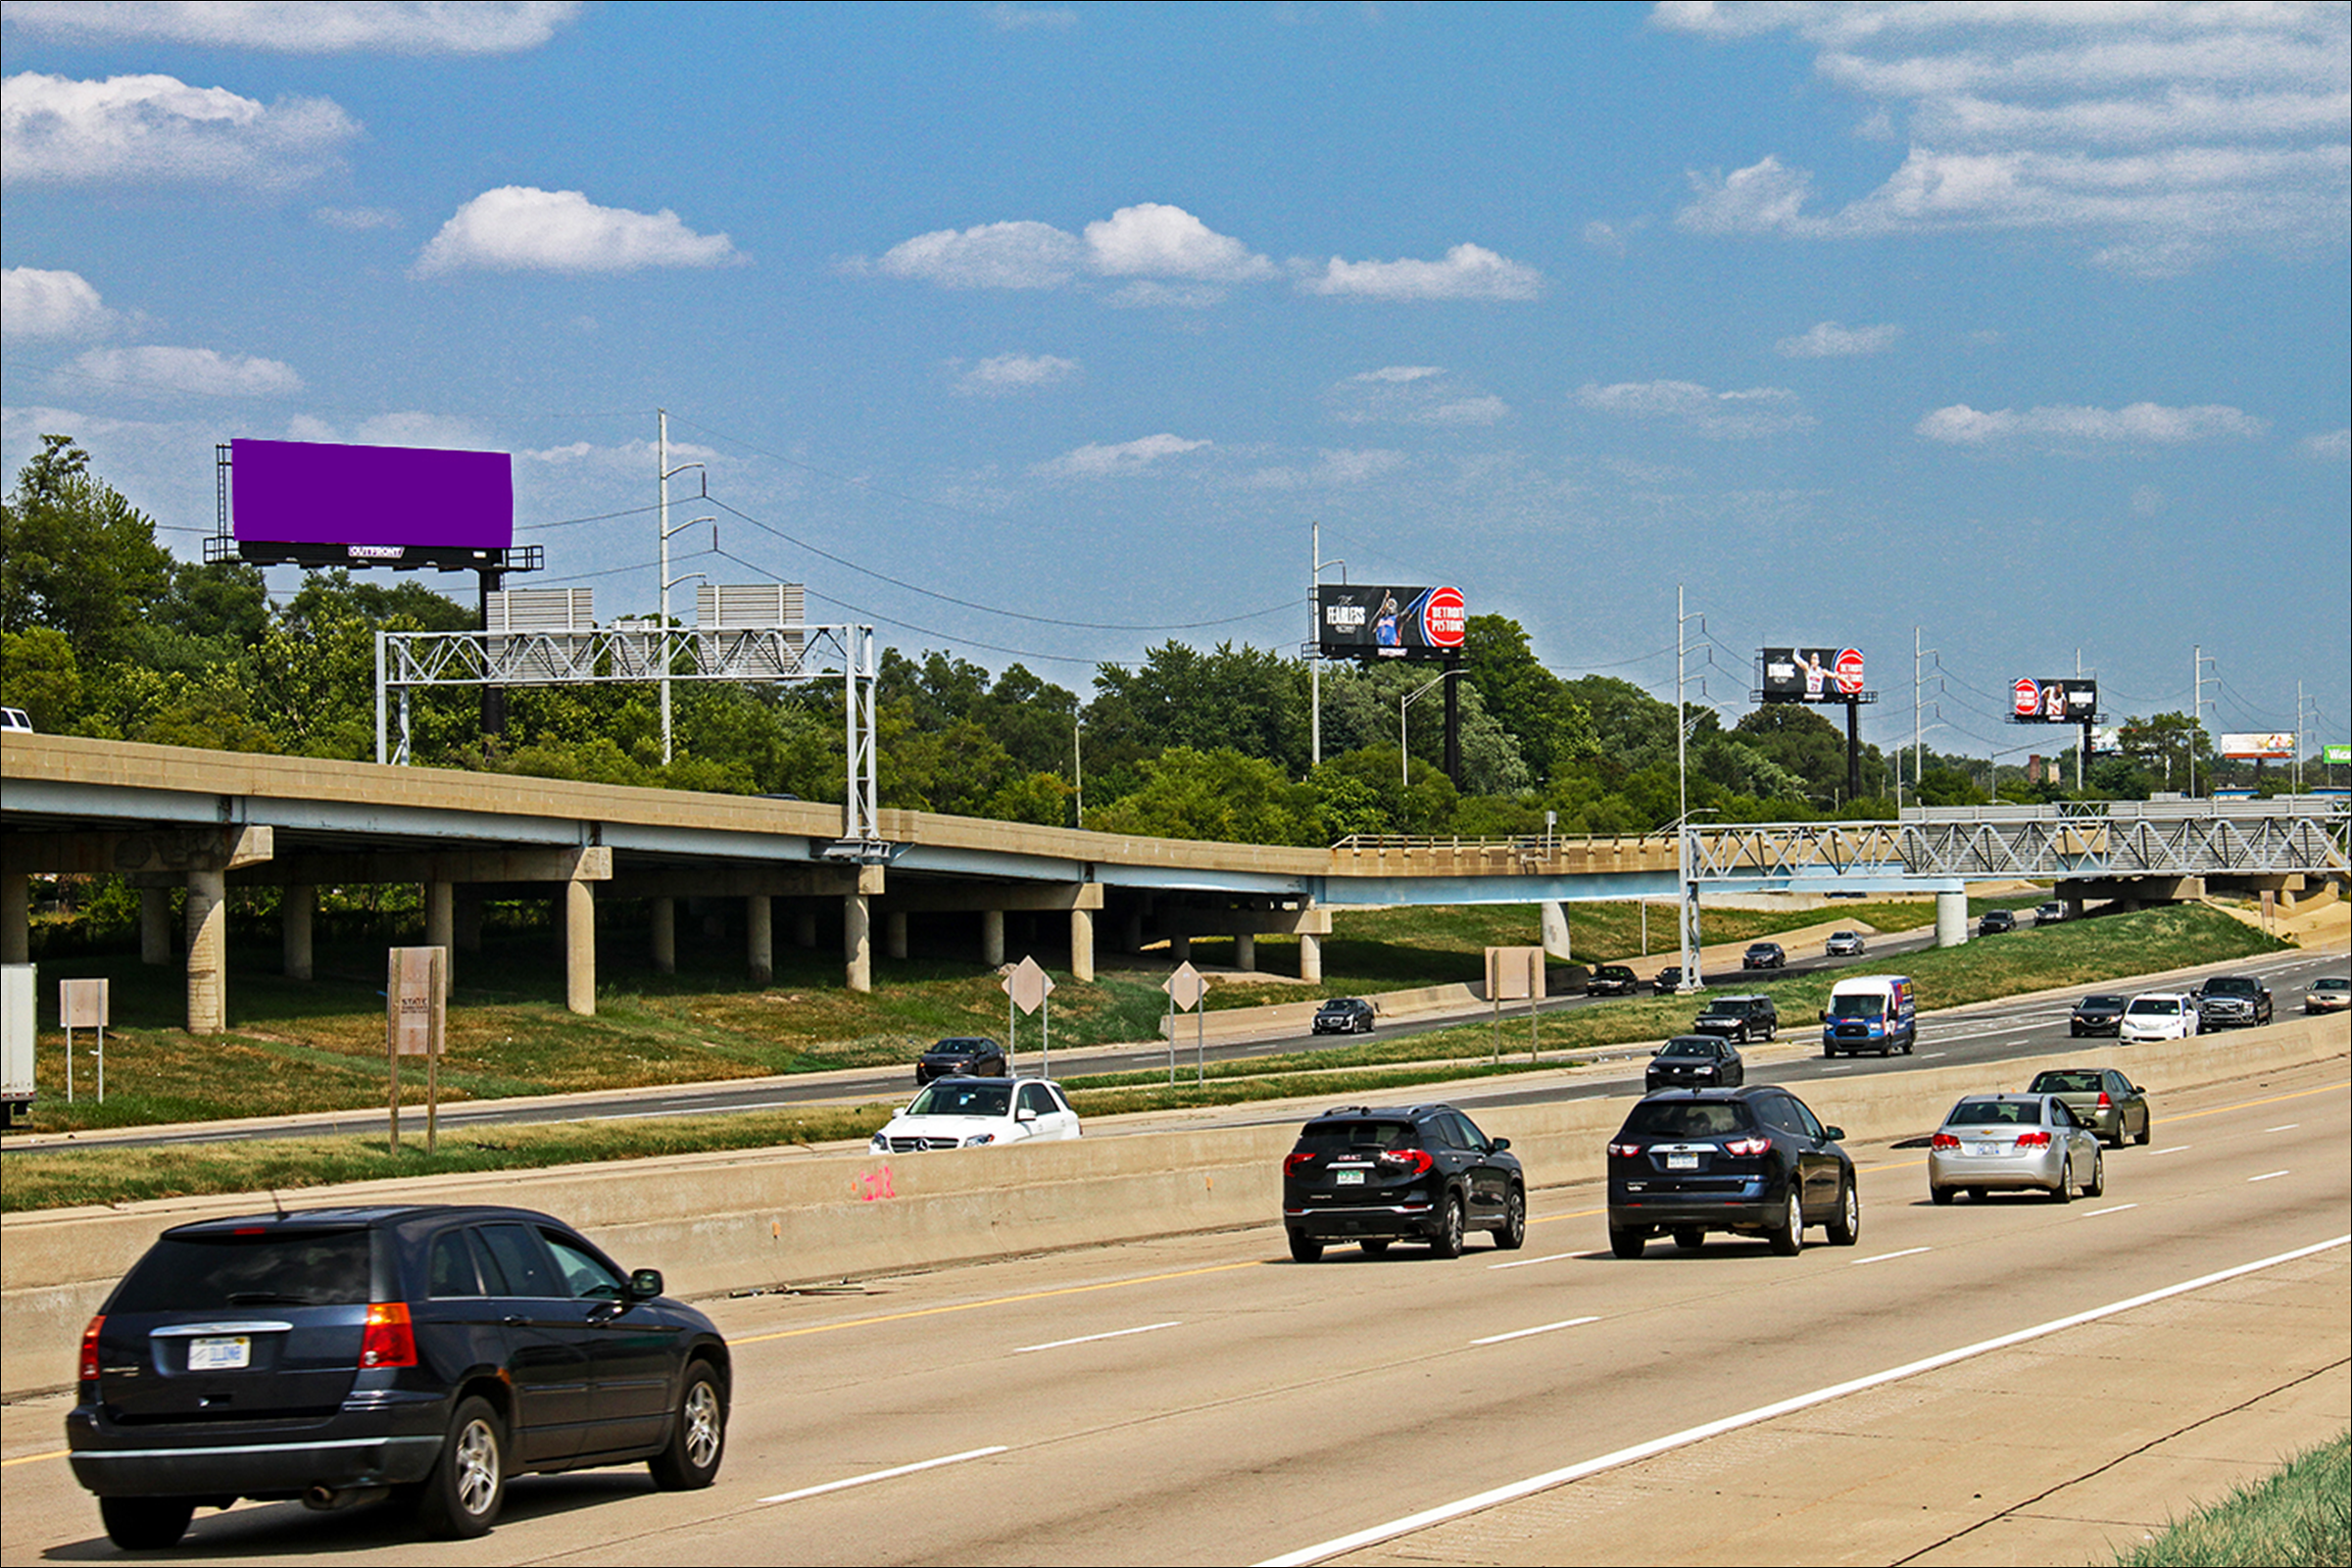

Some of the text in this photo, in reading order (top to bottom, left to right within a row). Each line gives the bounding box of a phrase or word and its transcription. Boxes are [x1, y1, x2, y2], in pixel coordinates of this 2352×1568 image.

[349, 547, 402, 557] OUTFRONT
[1326, 606, 1366, 625] FEARLESS
[1432, 607, 1464, 618] DETROIT
[1432, 619, 1464, 632] PISTONS
